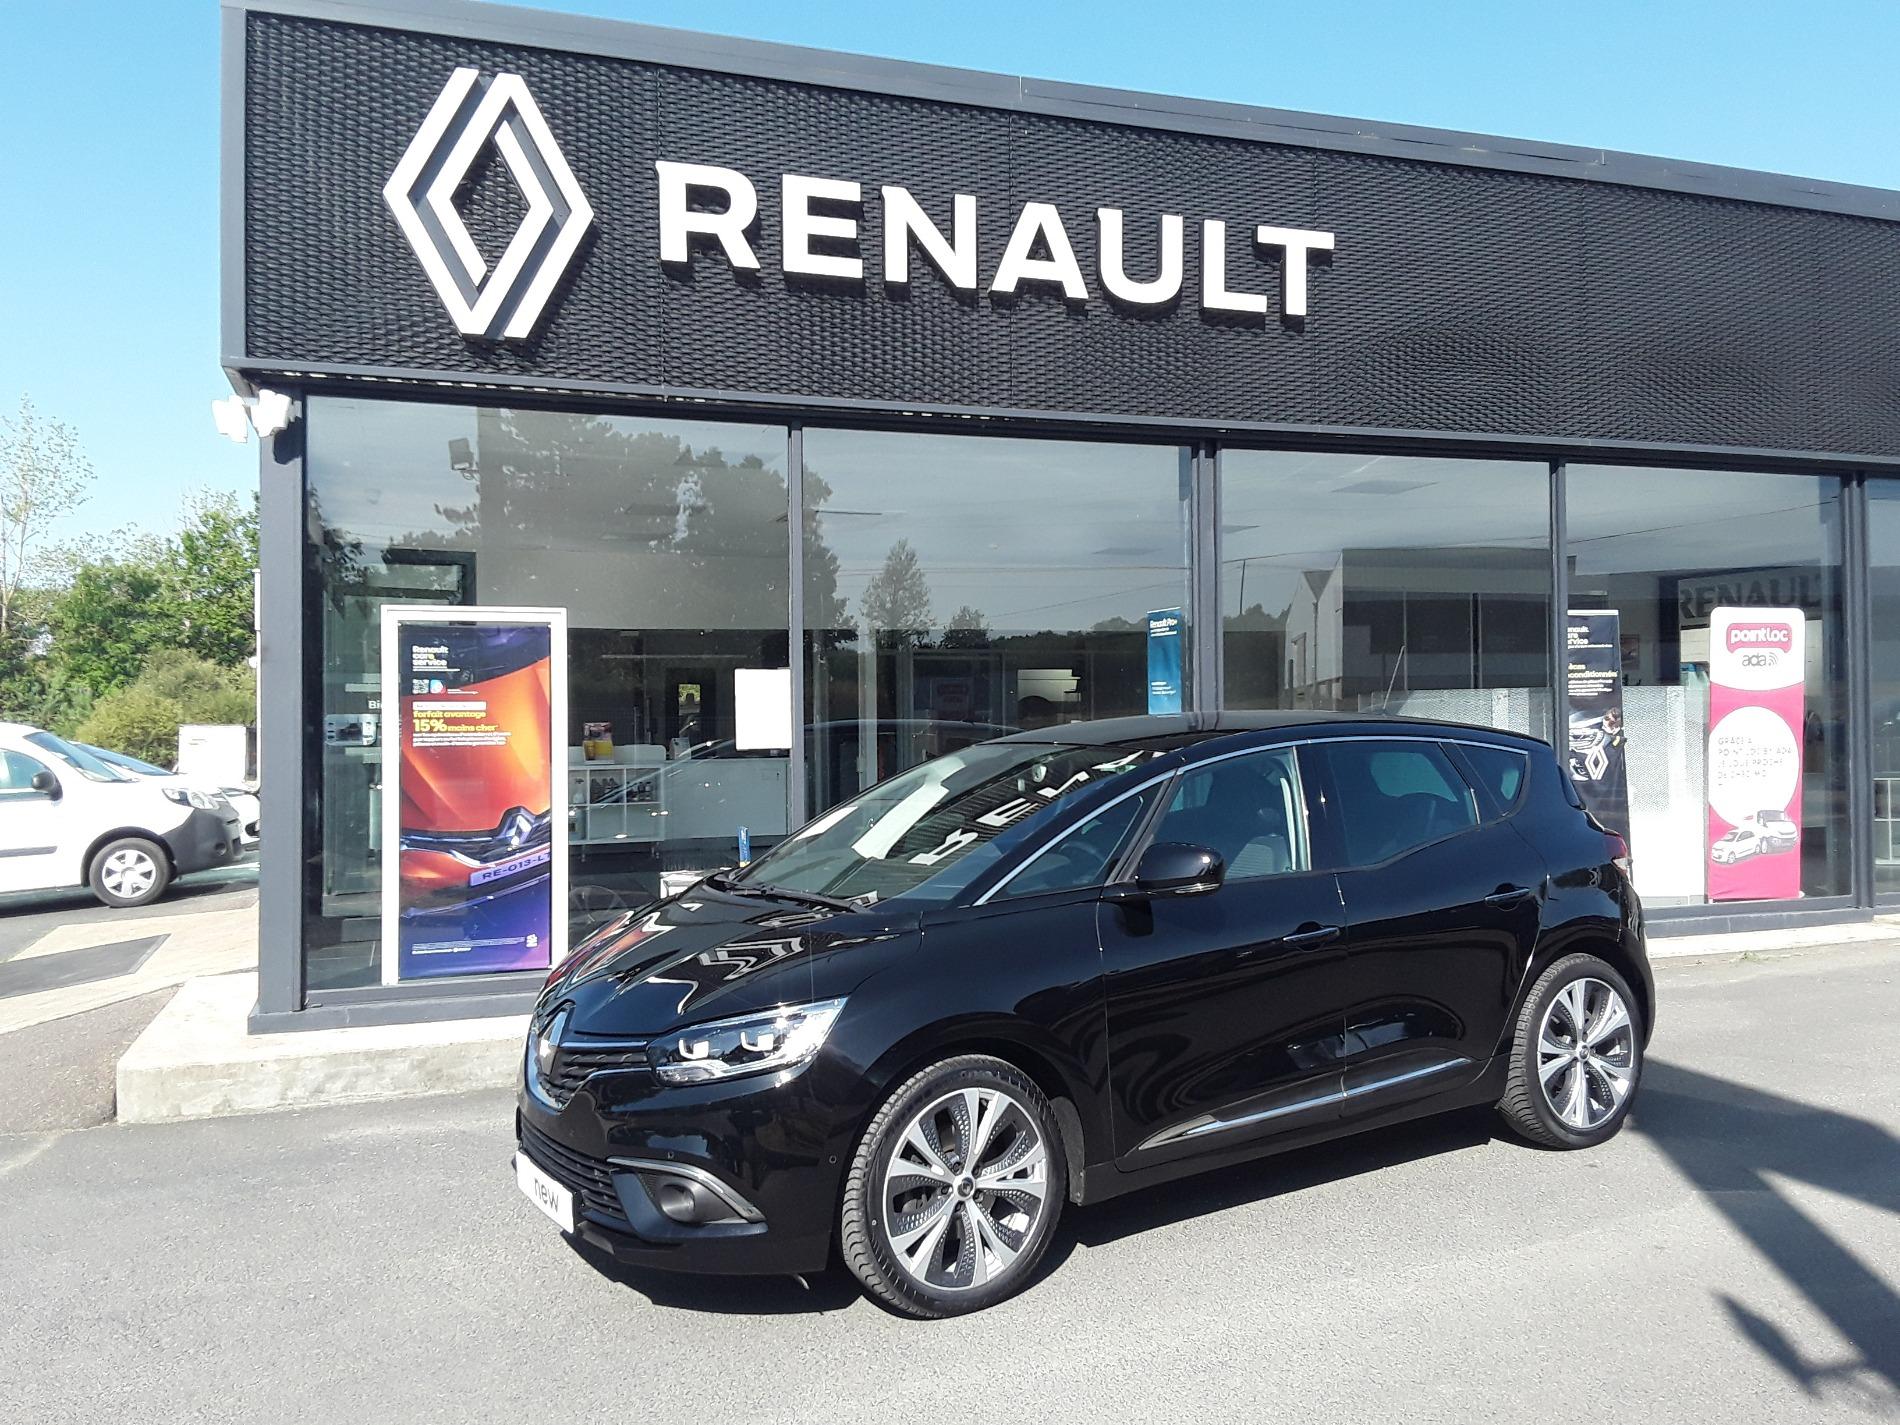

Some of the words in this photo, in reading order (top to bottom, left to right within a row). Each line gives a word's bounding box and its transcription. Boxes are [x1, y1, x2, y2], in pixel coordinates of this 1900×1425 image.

[655, 160, 1336, 317] RENAULT
[412, 645, 449, 654] Renault
[412, 658, 448, 666] service
[1741, 652, 1767, 667] ada
[412, 710, 444, 718] forfait
[443, 711, 487, 720] avantage
[412, 718, 448, 732] 15%
[447, 724, 476, 732] moins
[535, 1178, 559, 1213] new
